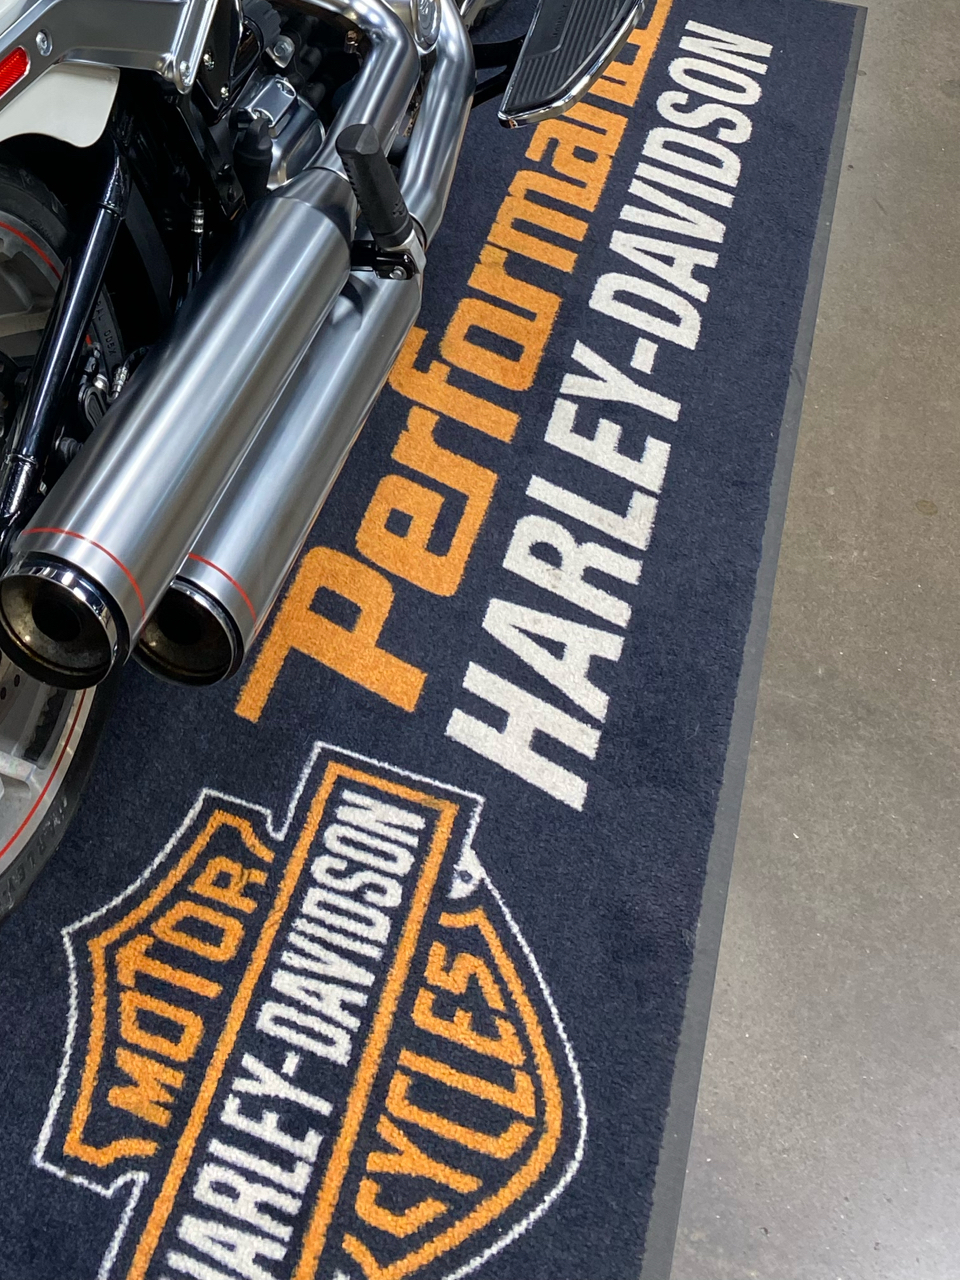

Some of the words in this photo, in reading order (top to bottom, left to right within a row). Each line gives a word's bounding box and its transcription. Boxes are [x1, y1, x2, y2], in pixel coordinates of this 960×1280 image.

[445, 18, 775, 812] HARLEY-DAVIDSON
[106, 855, 268, 1128] MOTOR
[354, 940, 537, 1239] CYCLES
